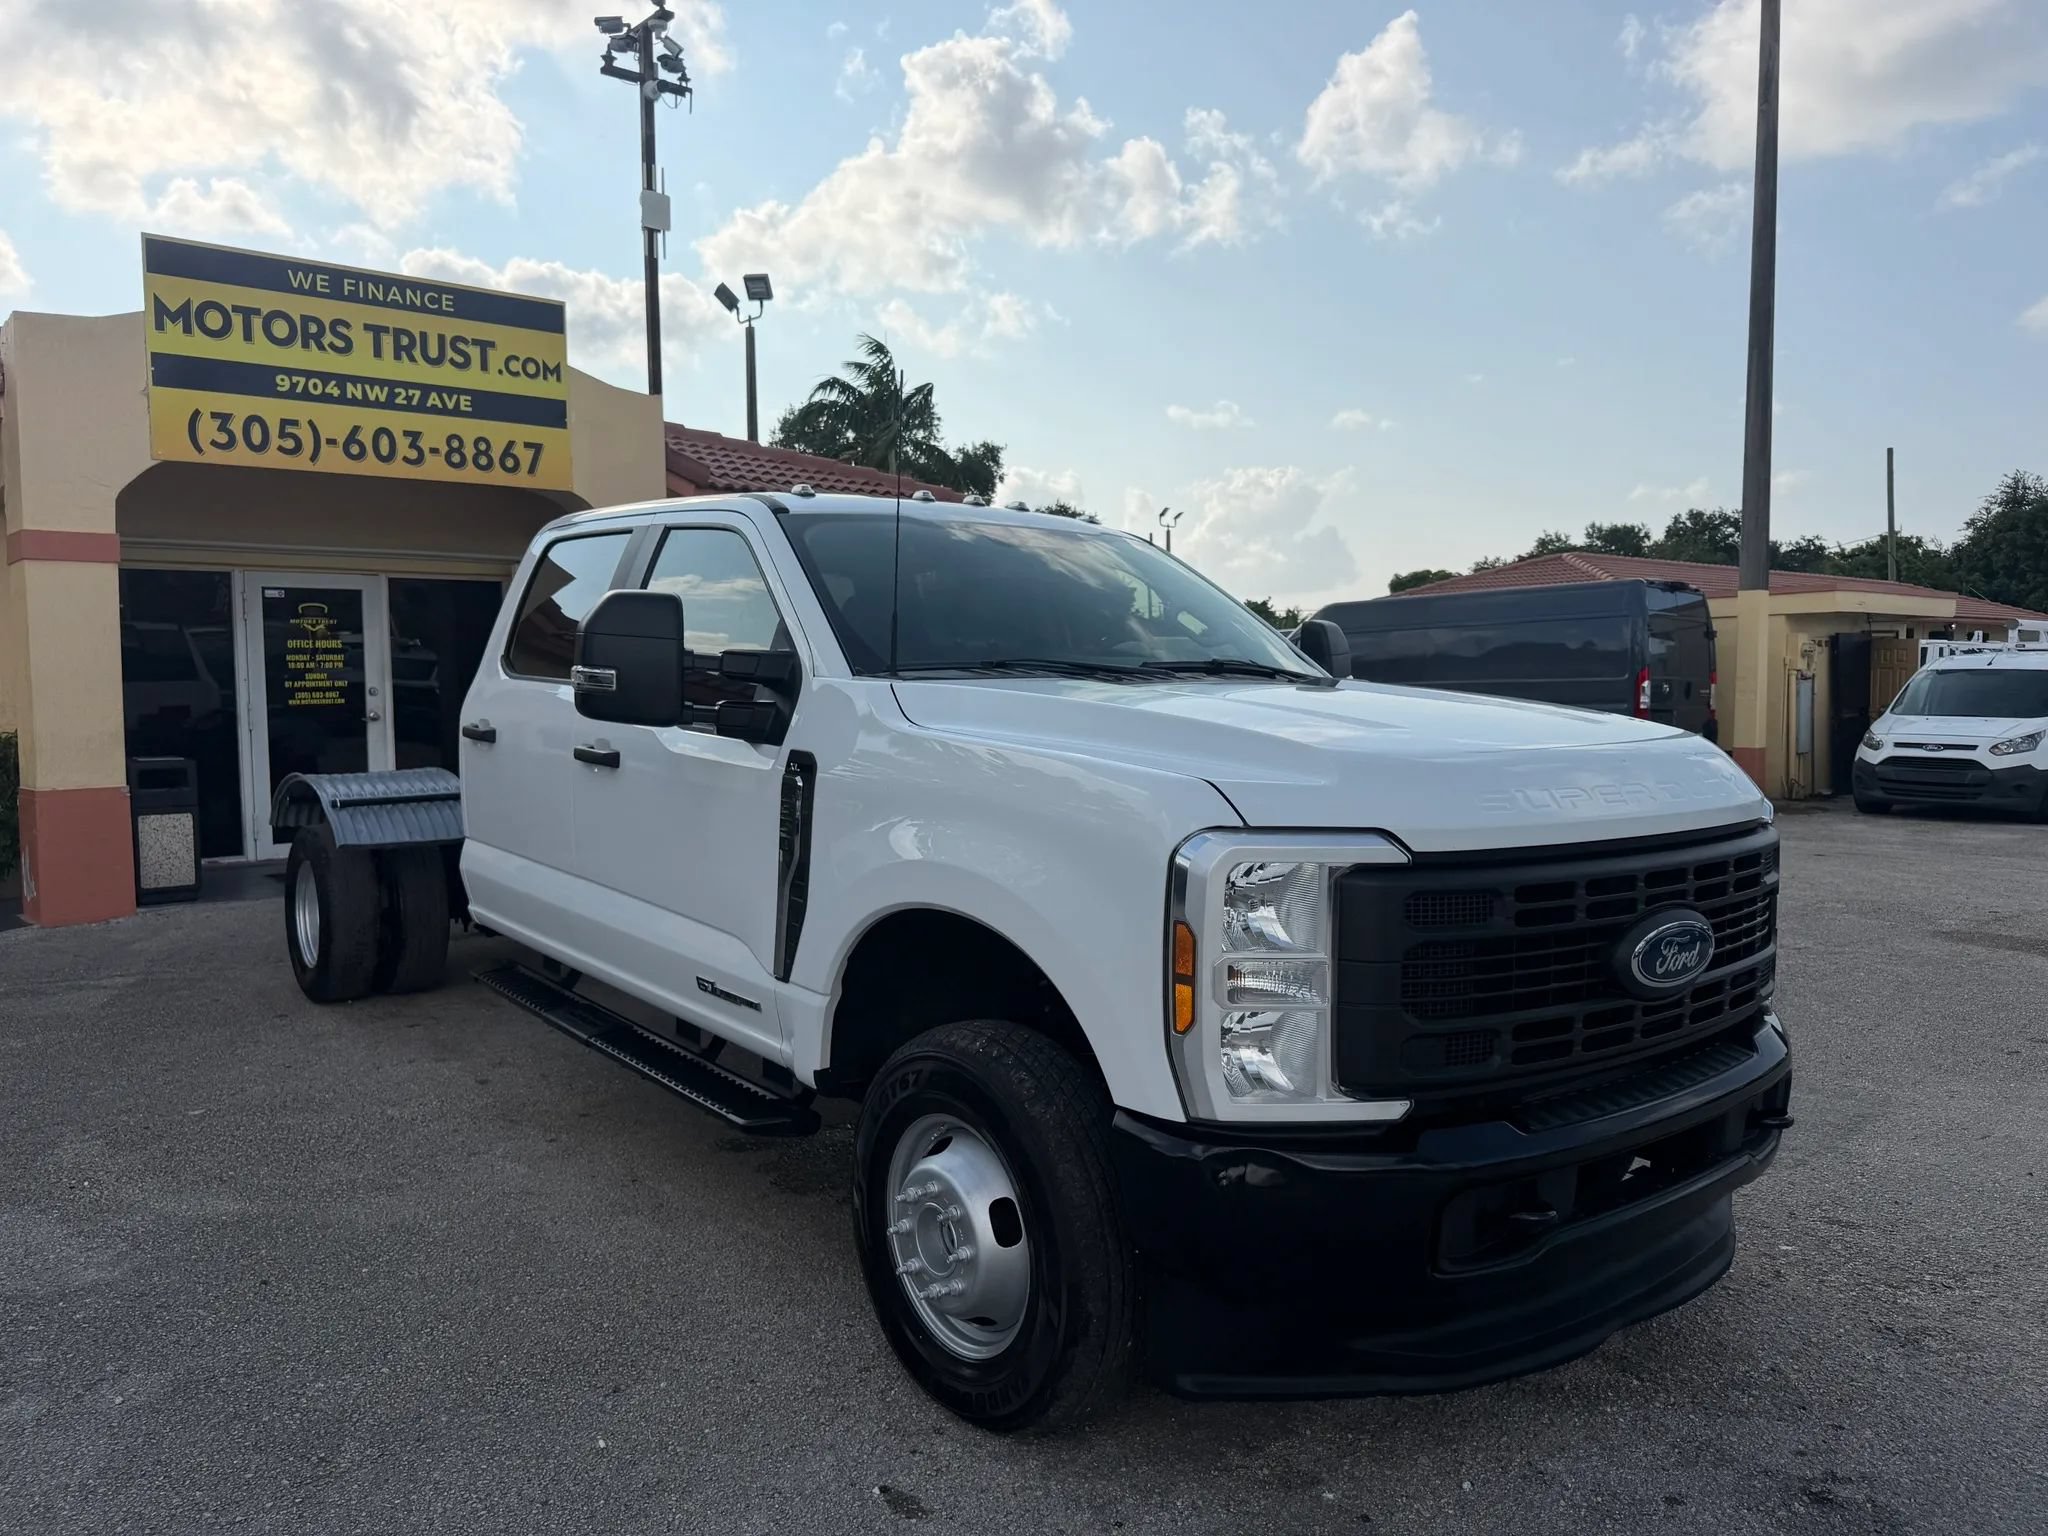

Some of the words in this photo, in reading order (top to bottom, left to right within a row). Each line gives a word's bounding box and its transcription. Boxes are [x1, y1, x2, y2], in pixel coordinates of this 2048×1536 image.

[287, 269, 330, 293] WE
[343, 278, 455, 312] FINANCE
[153, 292, 354, 356] MOTORS
[275, 374, 341, 398] 9704
[346, 382, 389, 402] NW
[394, 388, 421, 405] 27
[426, 392, 473, 411] AVE
[188, 407, 544, 477] (305)-603-8867
[287, 639, 314, 649] OFFICE
[315, 639, 343, 649] HOURS
[1480, 782, 1657, 813] SUPER
[1656, 931, 1700, 974] Ford
